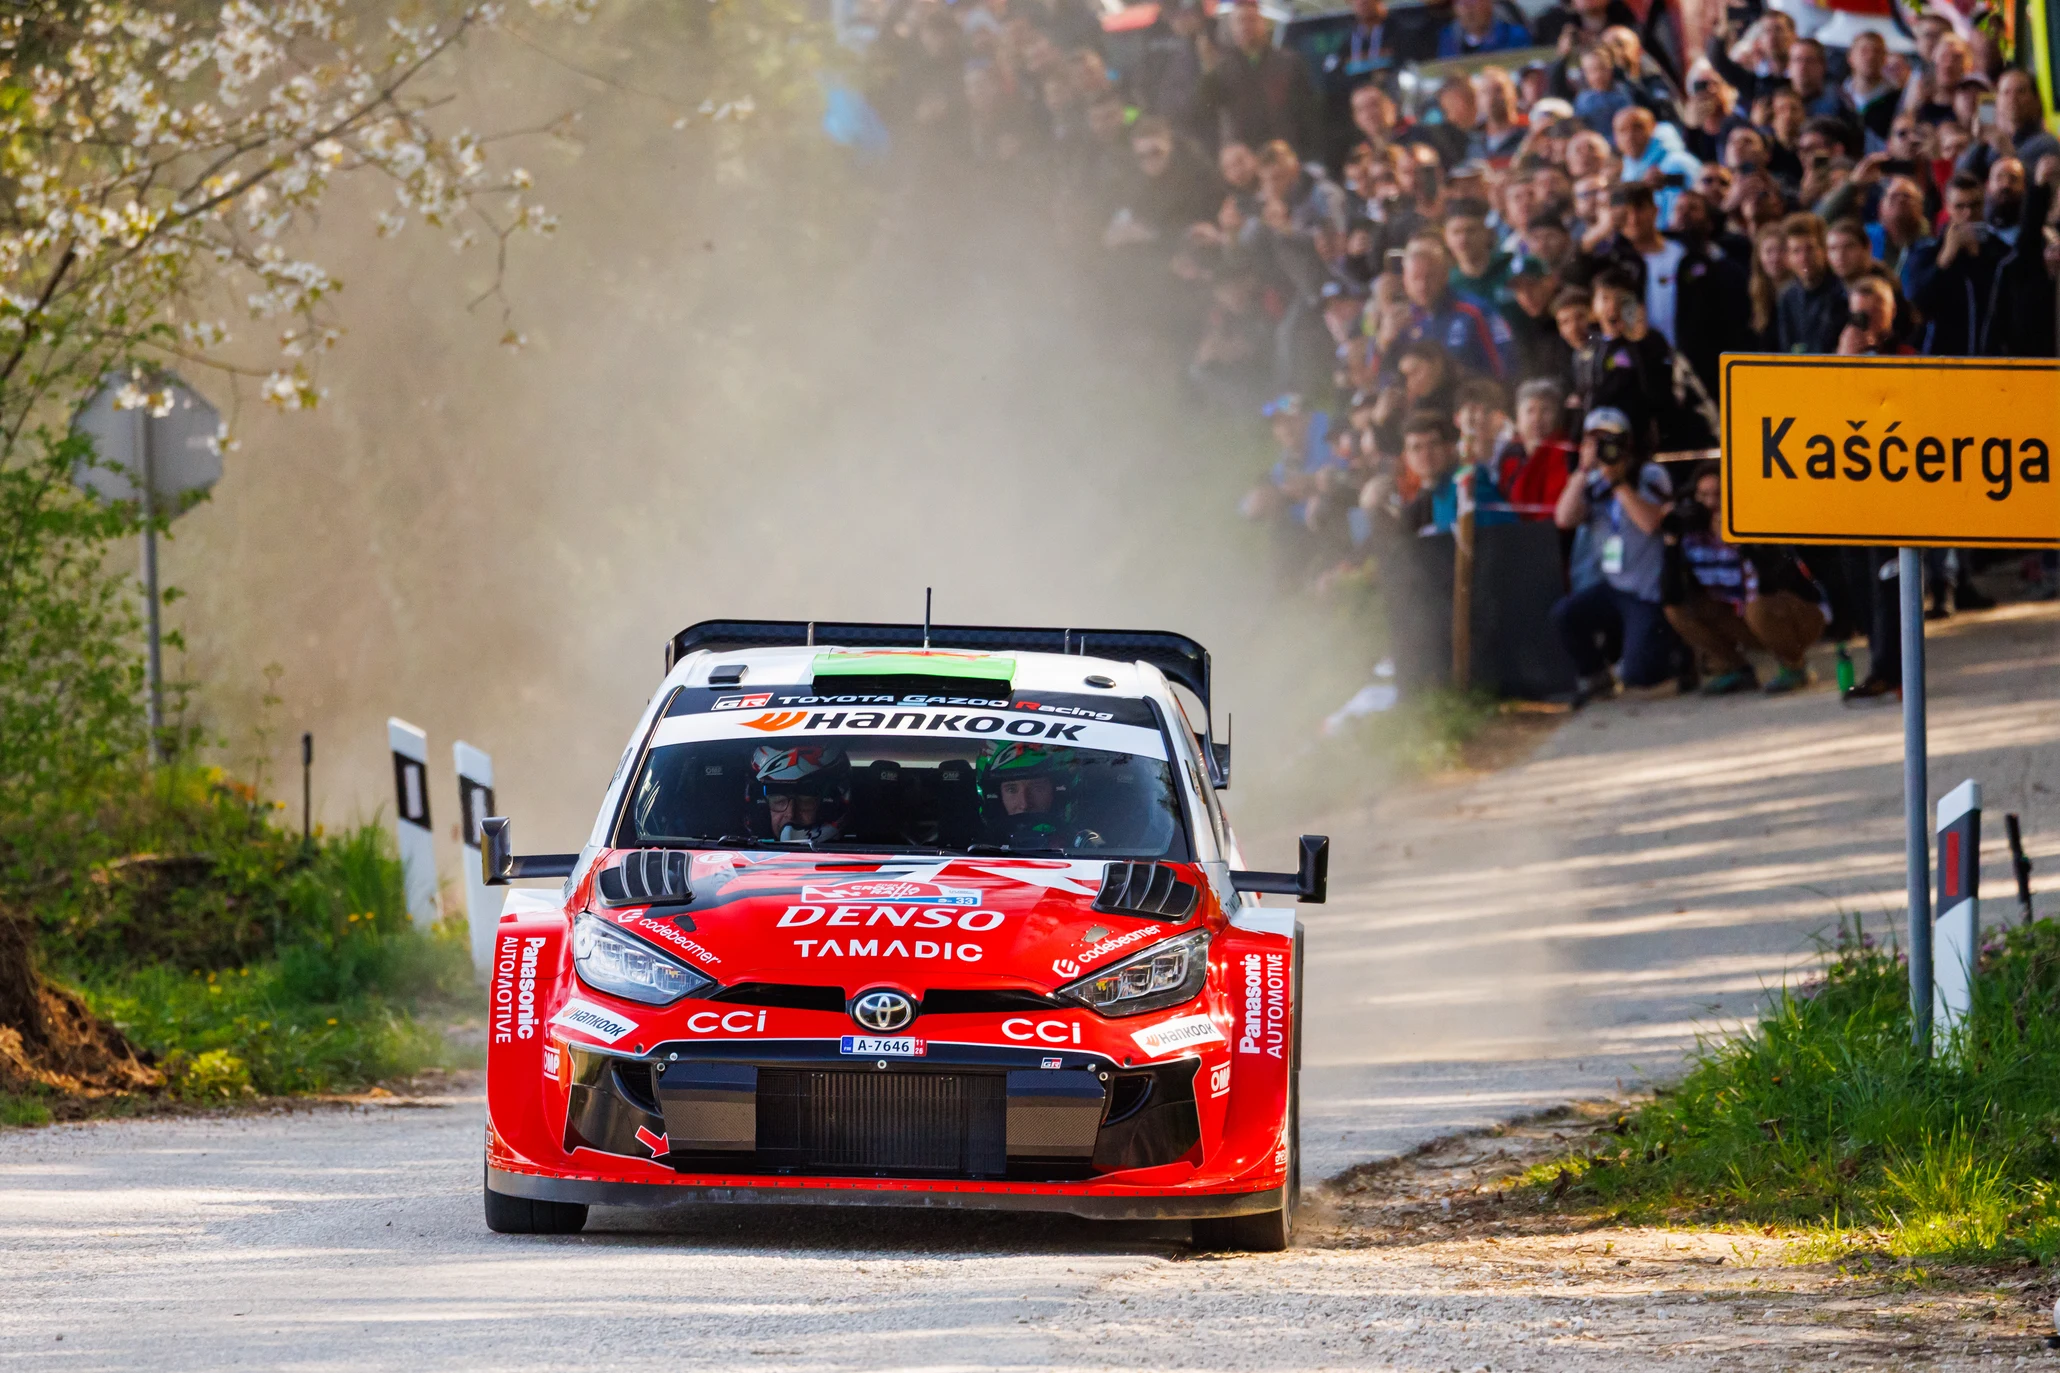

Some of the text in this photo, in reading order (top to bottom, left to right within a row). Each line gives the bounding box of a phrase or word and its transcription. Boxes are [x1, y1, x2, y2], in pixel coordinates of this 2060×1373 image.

[1761, 417, 2049, 501] Kašćerga
[778, 695, 894, 705] TOYOTA
[902, 694, 1009, 708] GAZOO
[1015, 701, 1114, 721] Racing
[955, 897, 974, 905] 33
[776, 905, 1005, 931] DENSO
[639, 917, 720, 964] codebeamer
[793, 939, 983, 962] TAMADIC
[1078, 925, 1160, 963] codebeamer
[495, 936, 518, 1044] AUTOMOTIVE
[517, 936, 546, 1039] Panasonic
[1239, 953, 1261, 1054] Panasonic
[1266, 953, 1283, 1059] AUTOMOTIVE
[857, 1039, 910, 1053] A-7646
[544, 1052, 560, 1074] OMP
[1042, 1058, 1062, 1069] GR
[1211, 1068, 1230, 1091] OMP
